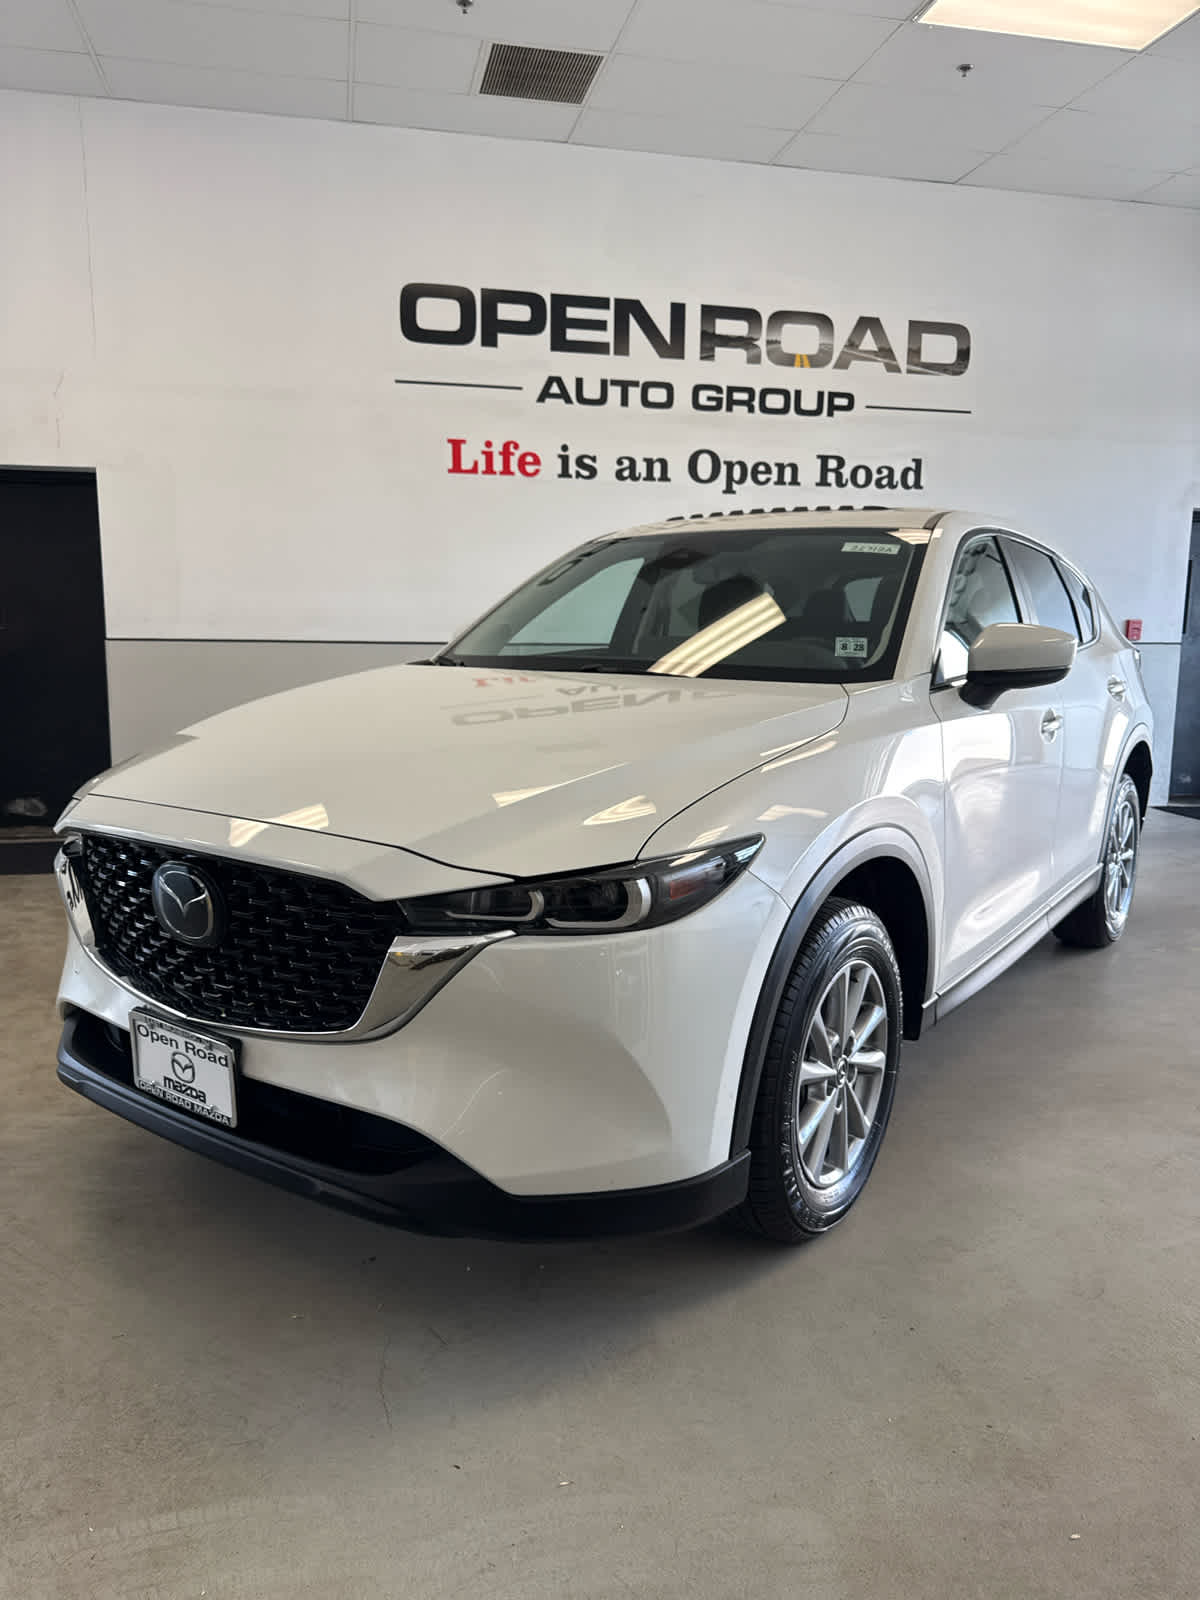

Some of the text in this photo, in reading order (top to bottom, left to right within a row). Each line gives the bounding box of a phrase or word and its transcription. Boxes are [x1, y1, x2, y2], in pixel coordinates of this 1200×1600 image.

[399, 283, 972, 377] OPEN ROAD
[535, 376, 855, 418] AUTO GROUP
[447, 439, 924, 495] Life is an Open Road
[137, 1024, 179, 1049] Open
[185, 1041, 229, 1067] Road
[166, 1093, 192, 1110] ROAD
[194, 1104, 231, 1125] MAZDA
